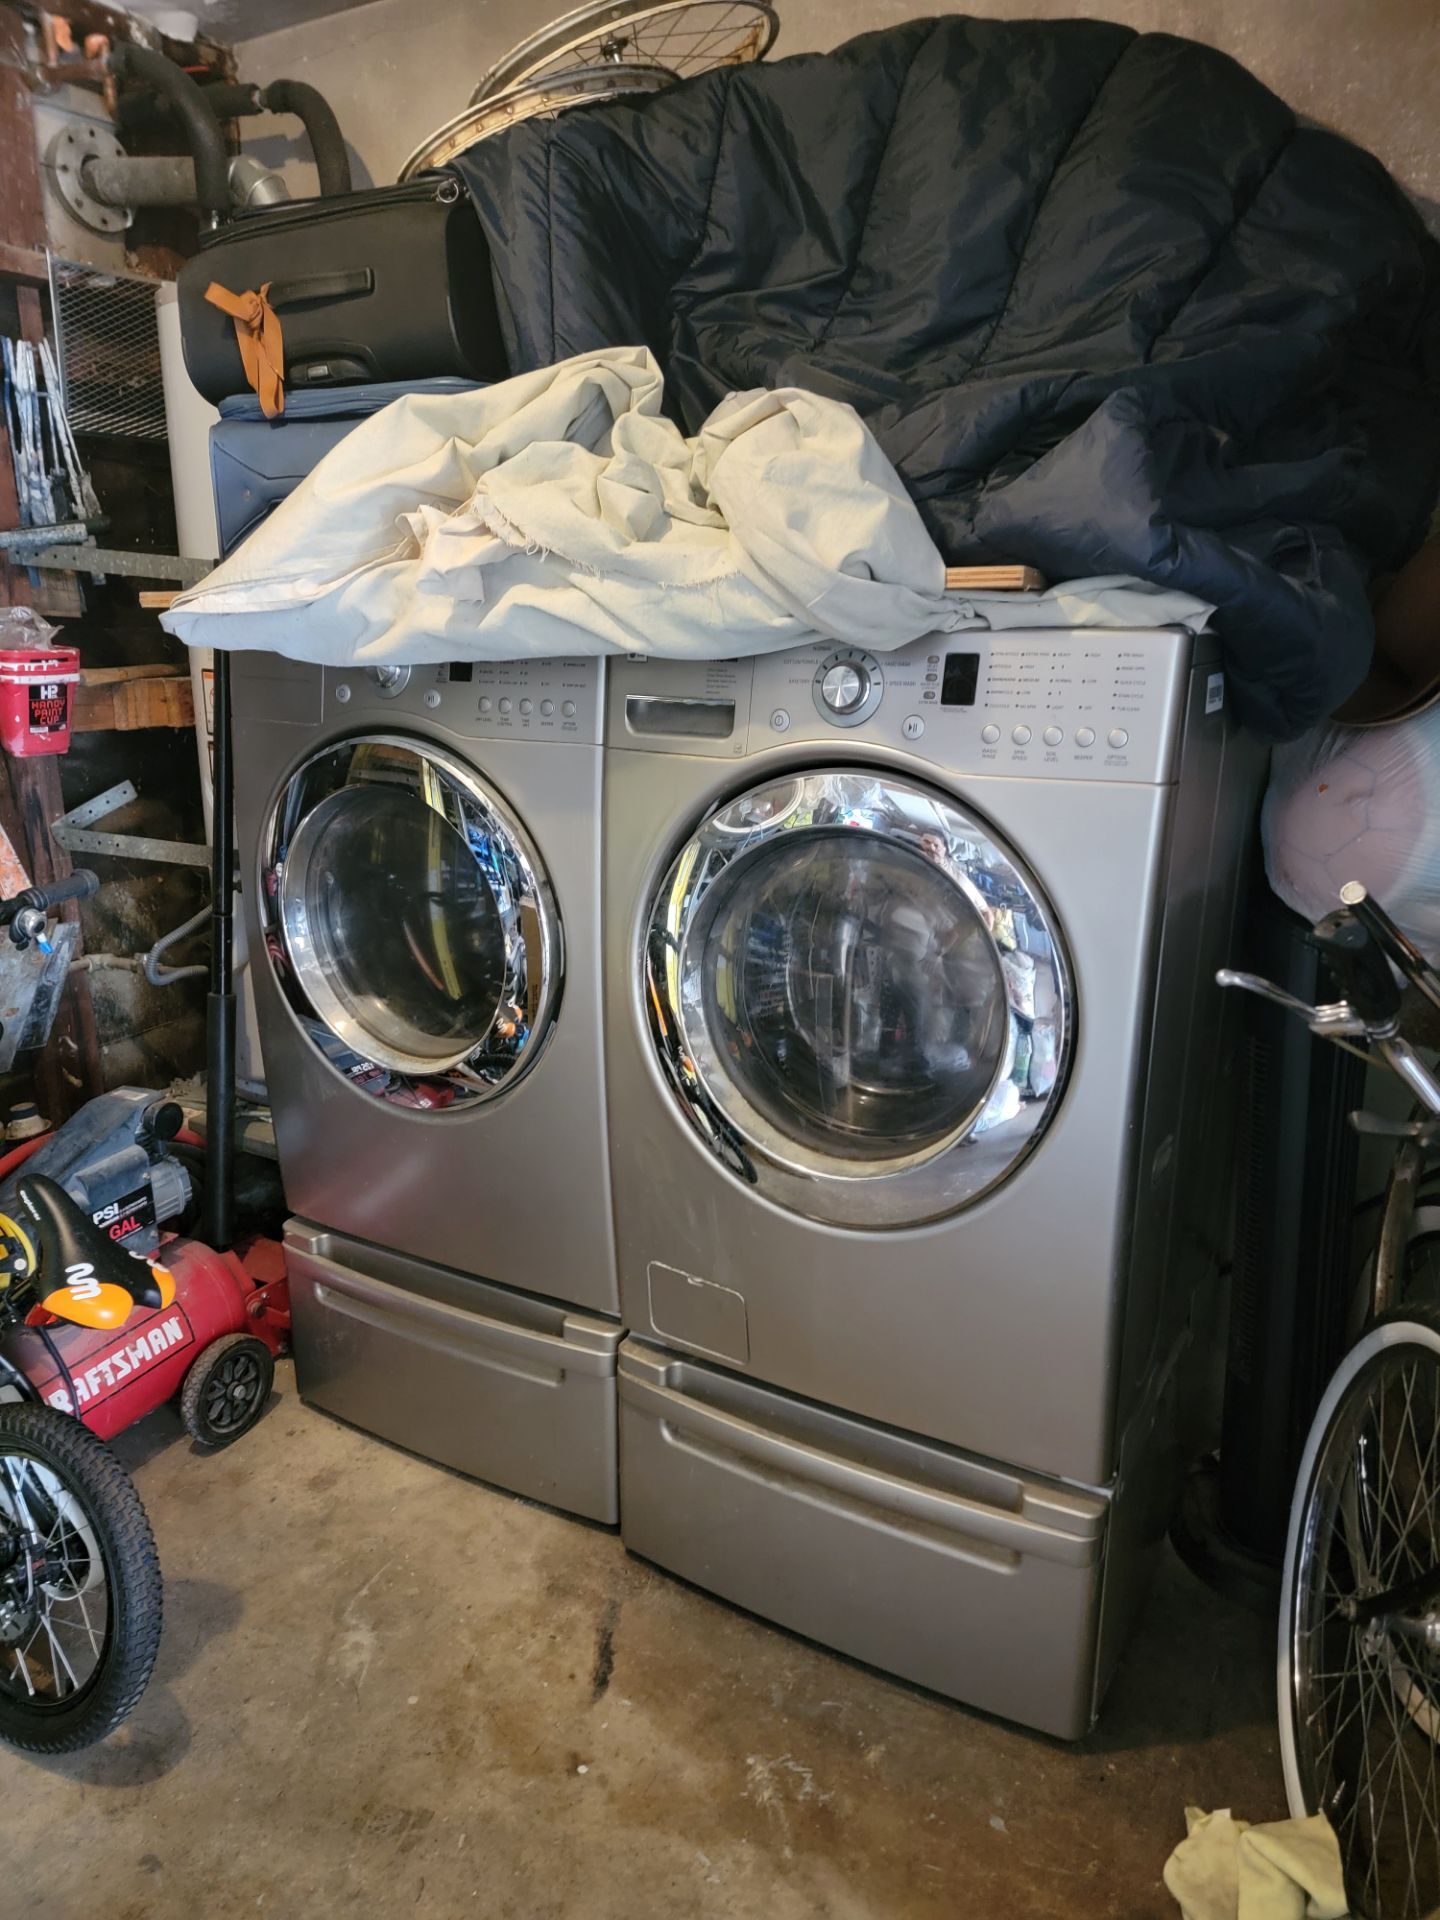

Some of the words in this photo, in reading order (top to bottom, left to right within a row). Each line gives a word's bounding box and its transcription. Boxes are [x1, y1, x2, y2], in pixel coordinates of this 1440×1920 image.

[31, 698, 65, 710] HANDY
[34, 707, 63, 718] PAINT
[40, 716, 60, 725] CUP
[92, 1202, 120, 1226] PSI
[108, 1215, 141, 1240] GAL
[44, 1316, 184, 1413] RAFTSMAN
